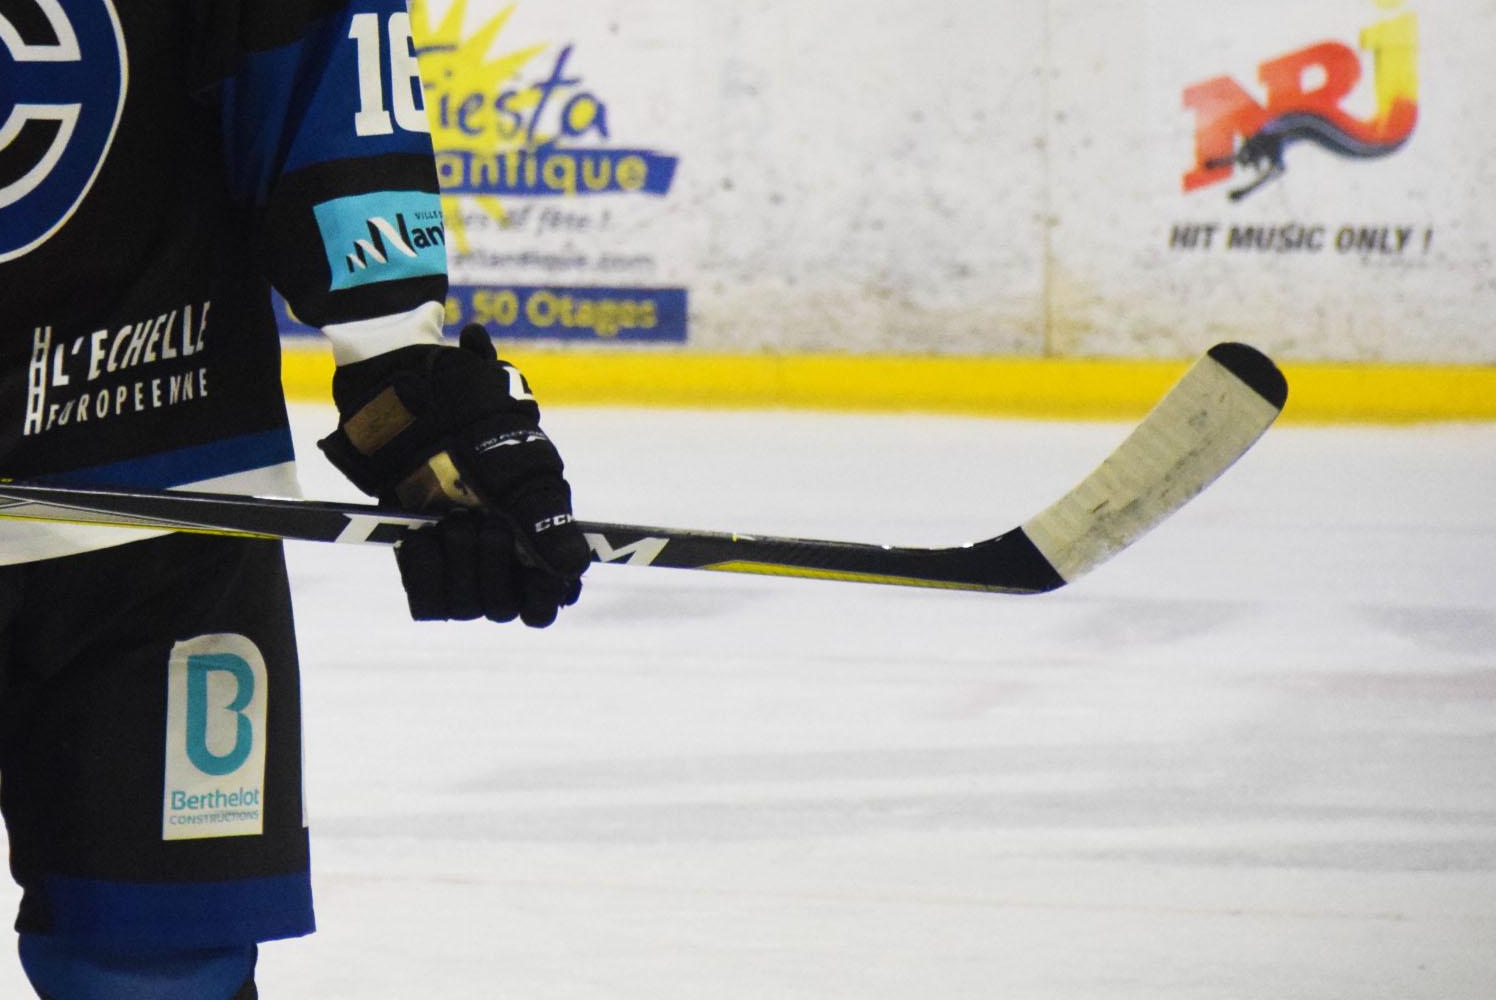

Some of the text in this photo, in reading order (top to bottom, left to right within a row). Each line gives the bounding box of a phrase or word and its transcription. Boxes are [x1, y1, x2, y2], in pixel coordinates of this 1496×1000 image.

[348, 12, 431, 136] 16
[1168, 224, 1218, 249] HIT
[1226, 225, 1325, 252] MUSIC
[1334, 226, 1412, 256] ONLY
[471, 290, 518, 326] 50
[170, 786, 259, 811] Berthelot
